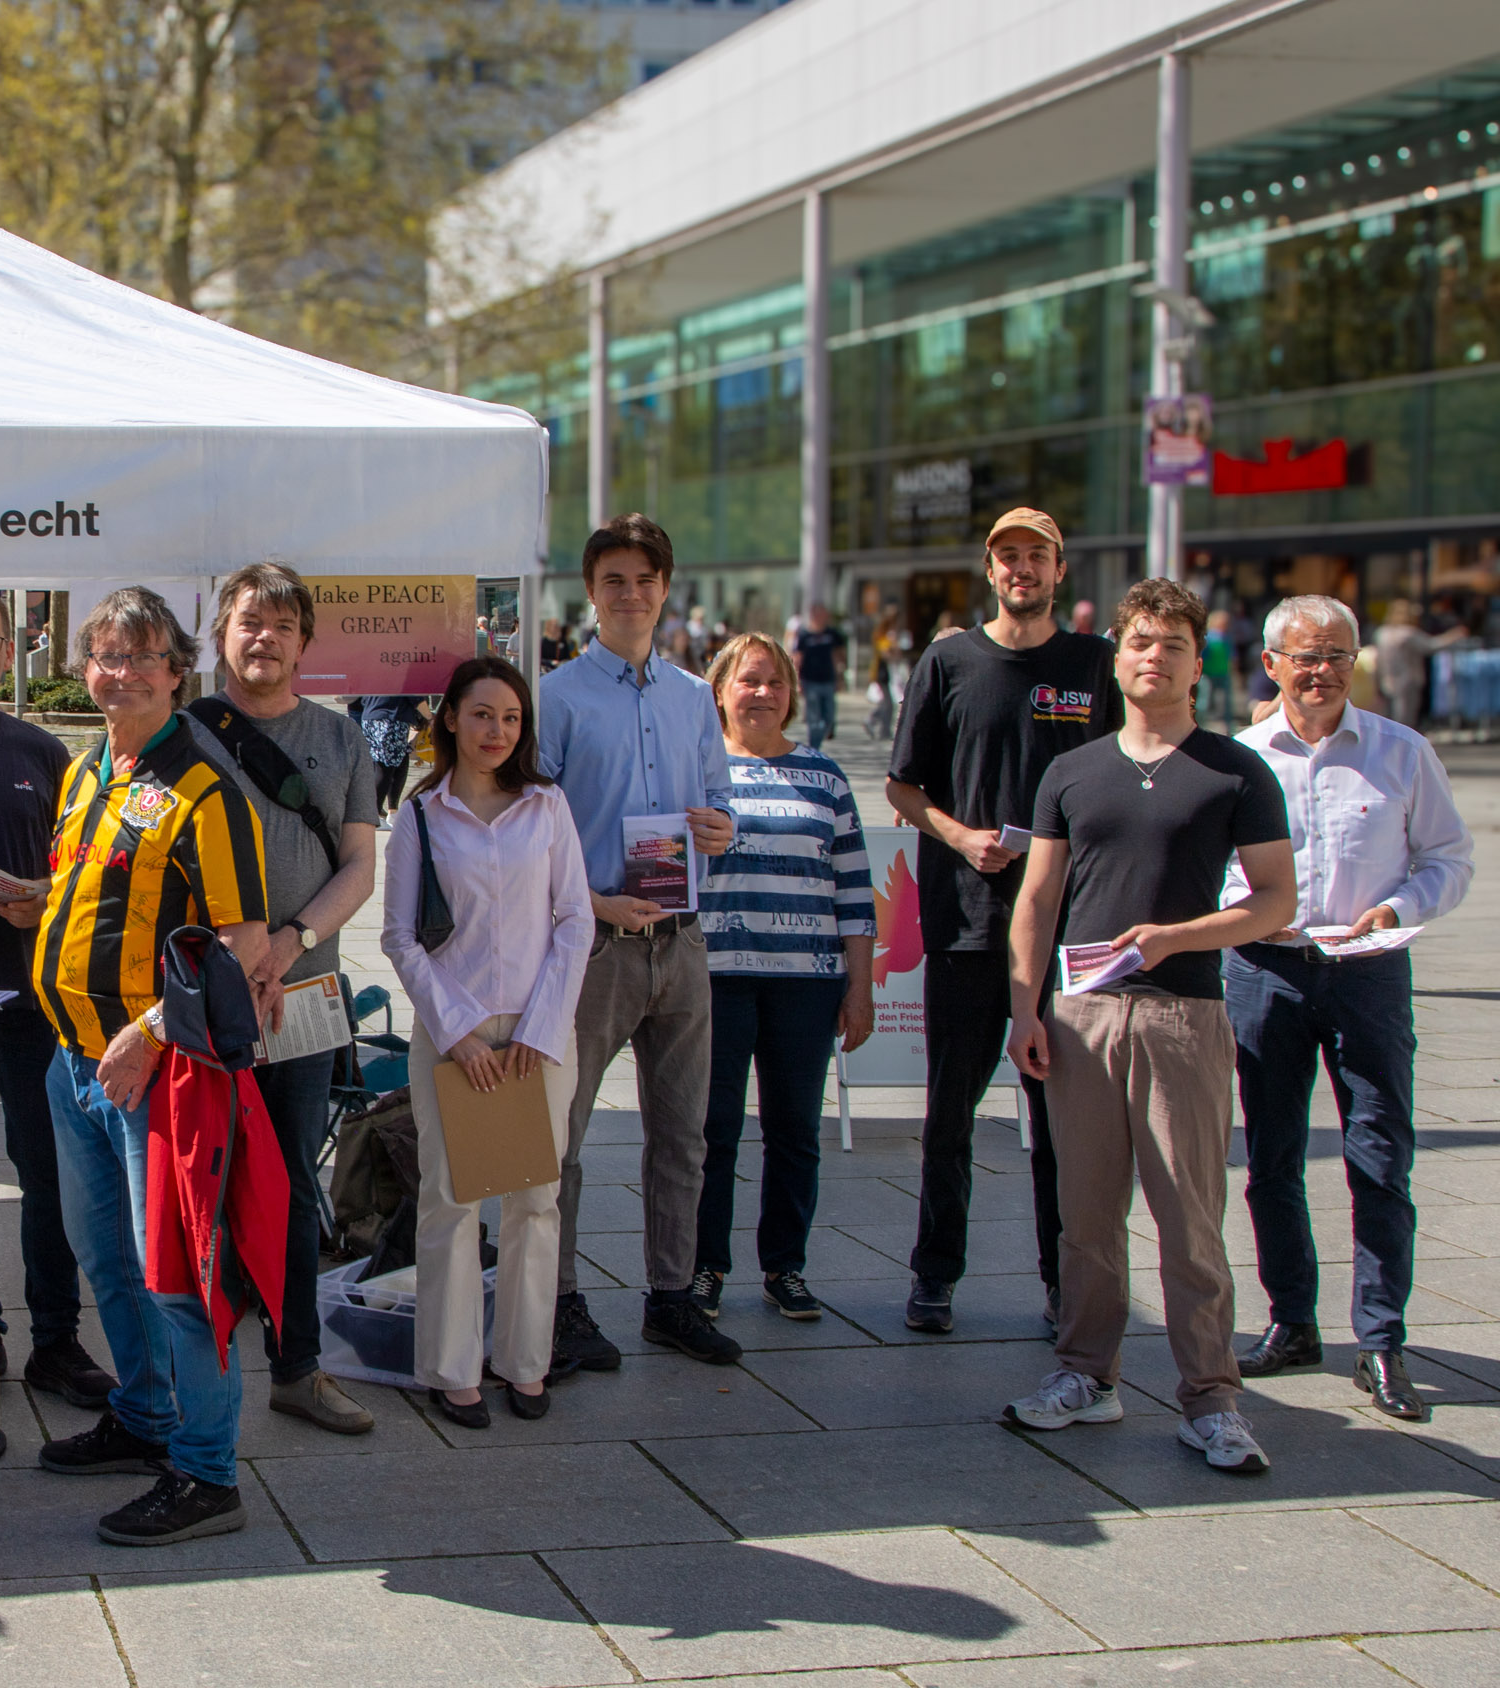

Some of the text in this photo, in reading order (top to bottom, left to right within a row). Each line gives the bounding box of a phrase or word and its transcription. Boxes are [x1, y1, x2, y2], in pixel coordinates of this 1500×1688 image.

[366, 584, 445, 604] PEACE
[340, 616, 413, 634] GREAT
[379, 645, 437, 667] again!
[1058, 691, 1092, 706] JSW
[67, 843, 129, 872] VEOLIA
[891, 1001, 924, 1010] Friede
[878, 1013, 925, 1021] den Fried
[878, 1024, 897, 1033] den
